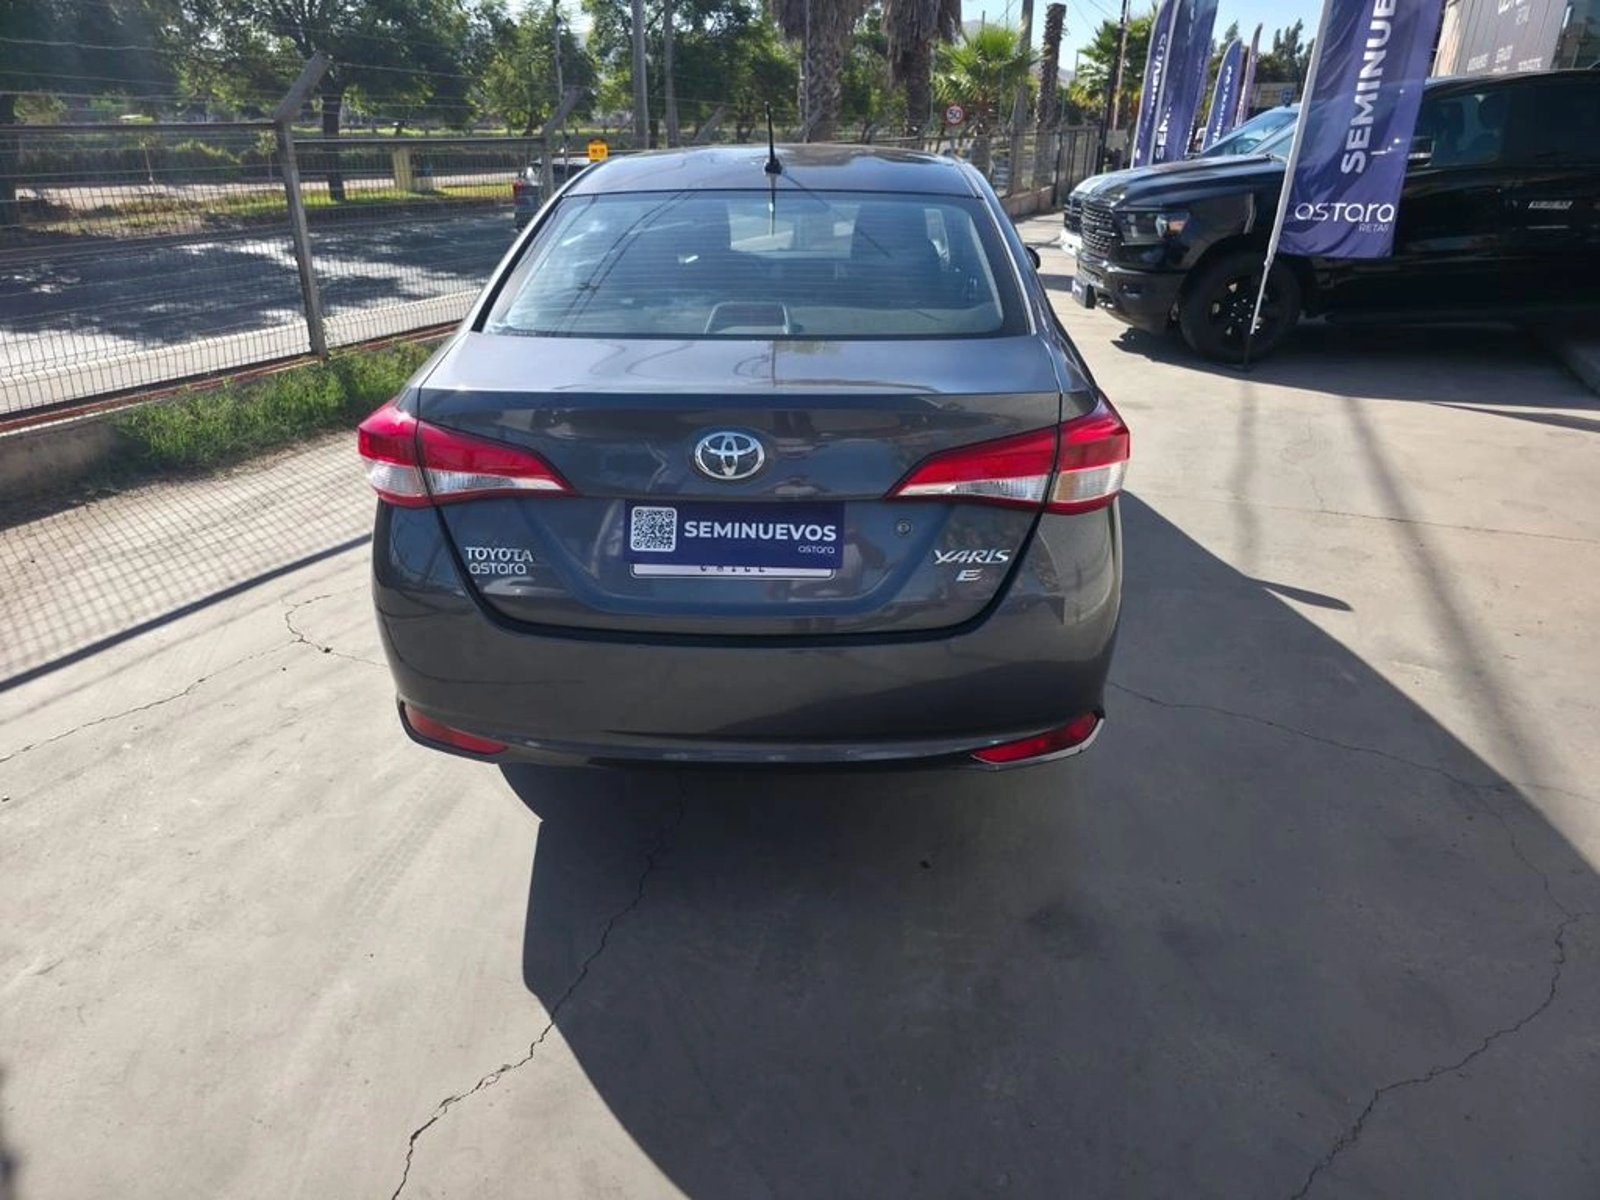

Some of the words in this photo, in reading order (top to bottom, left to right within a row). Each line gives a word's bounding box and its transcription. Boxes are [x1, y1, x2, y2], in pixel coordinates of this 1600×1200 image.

[1341, 0, 1397, 175] SEMINUE
[949, 109, 962, 120] 50
[1295, 202, 1395, 224] astara
[684, 521, 837, 542] SEMINUEVOS
[465, 547, 534, 563] TOYOTA
[798, 544, 835, 555] astara
[934, 548, 1012, 565] YARIS
[469, 562, 527, 575] astara
[956, 568, 984, 582] E
